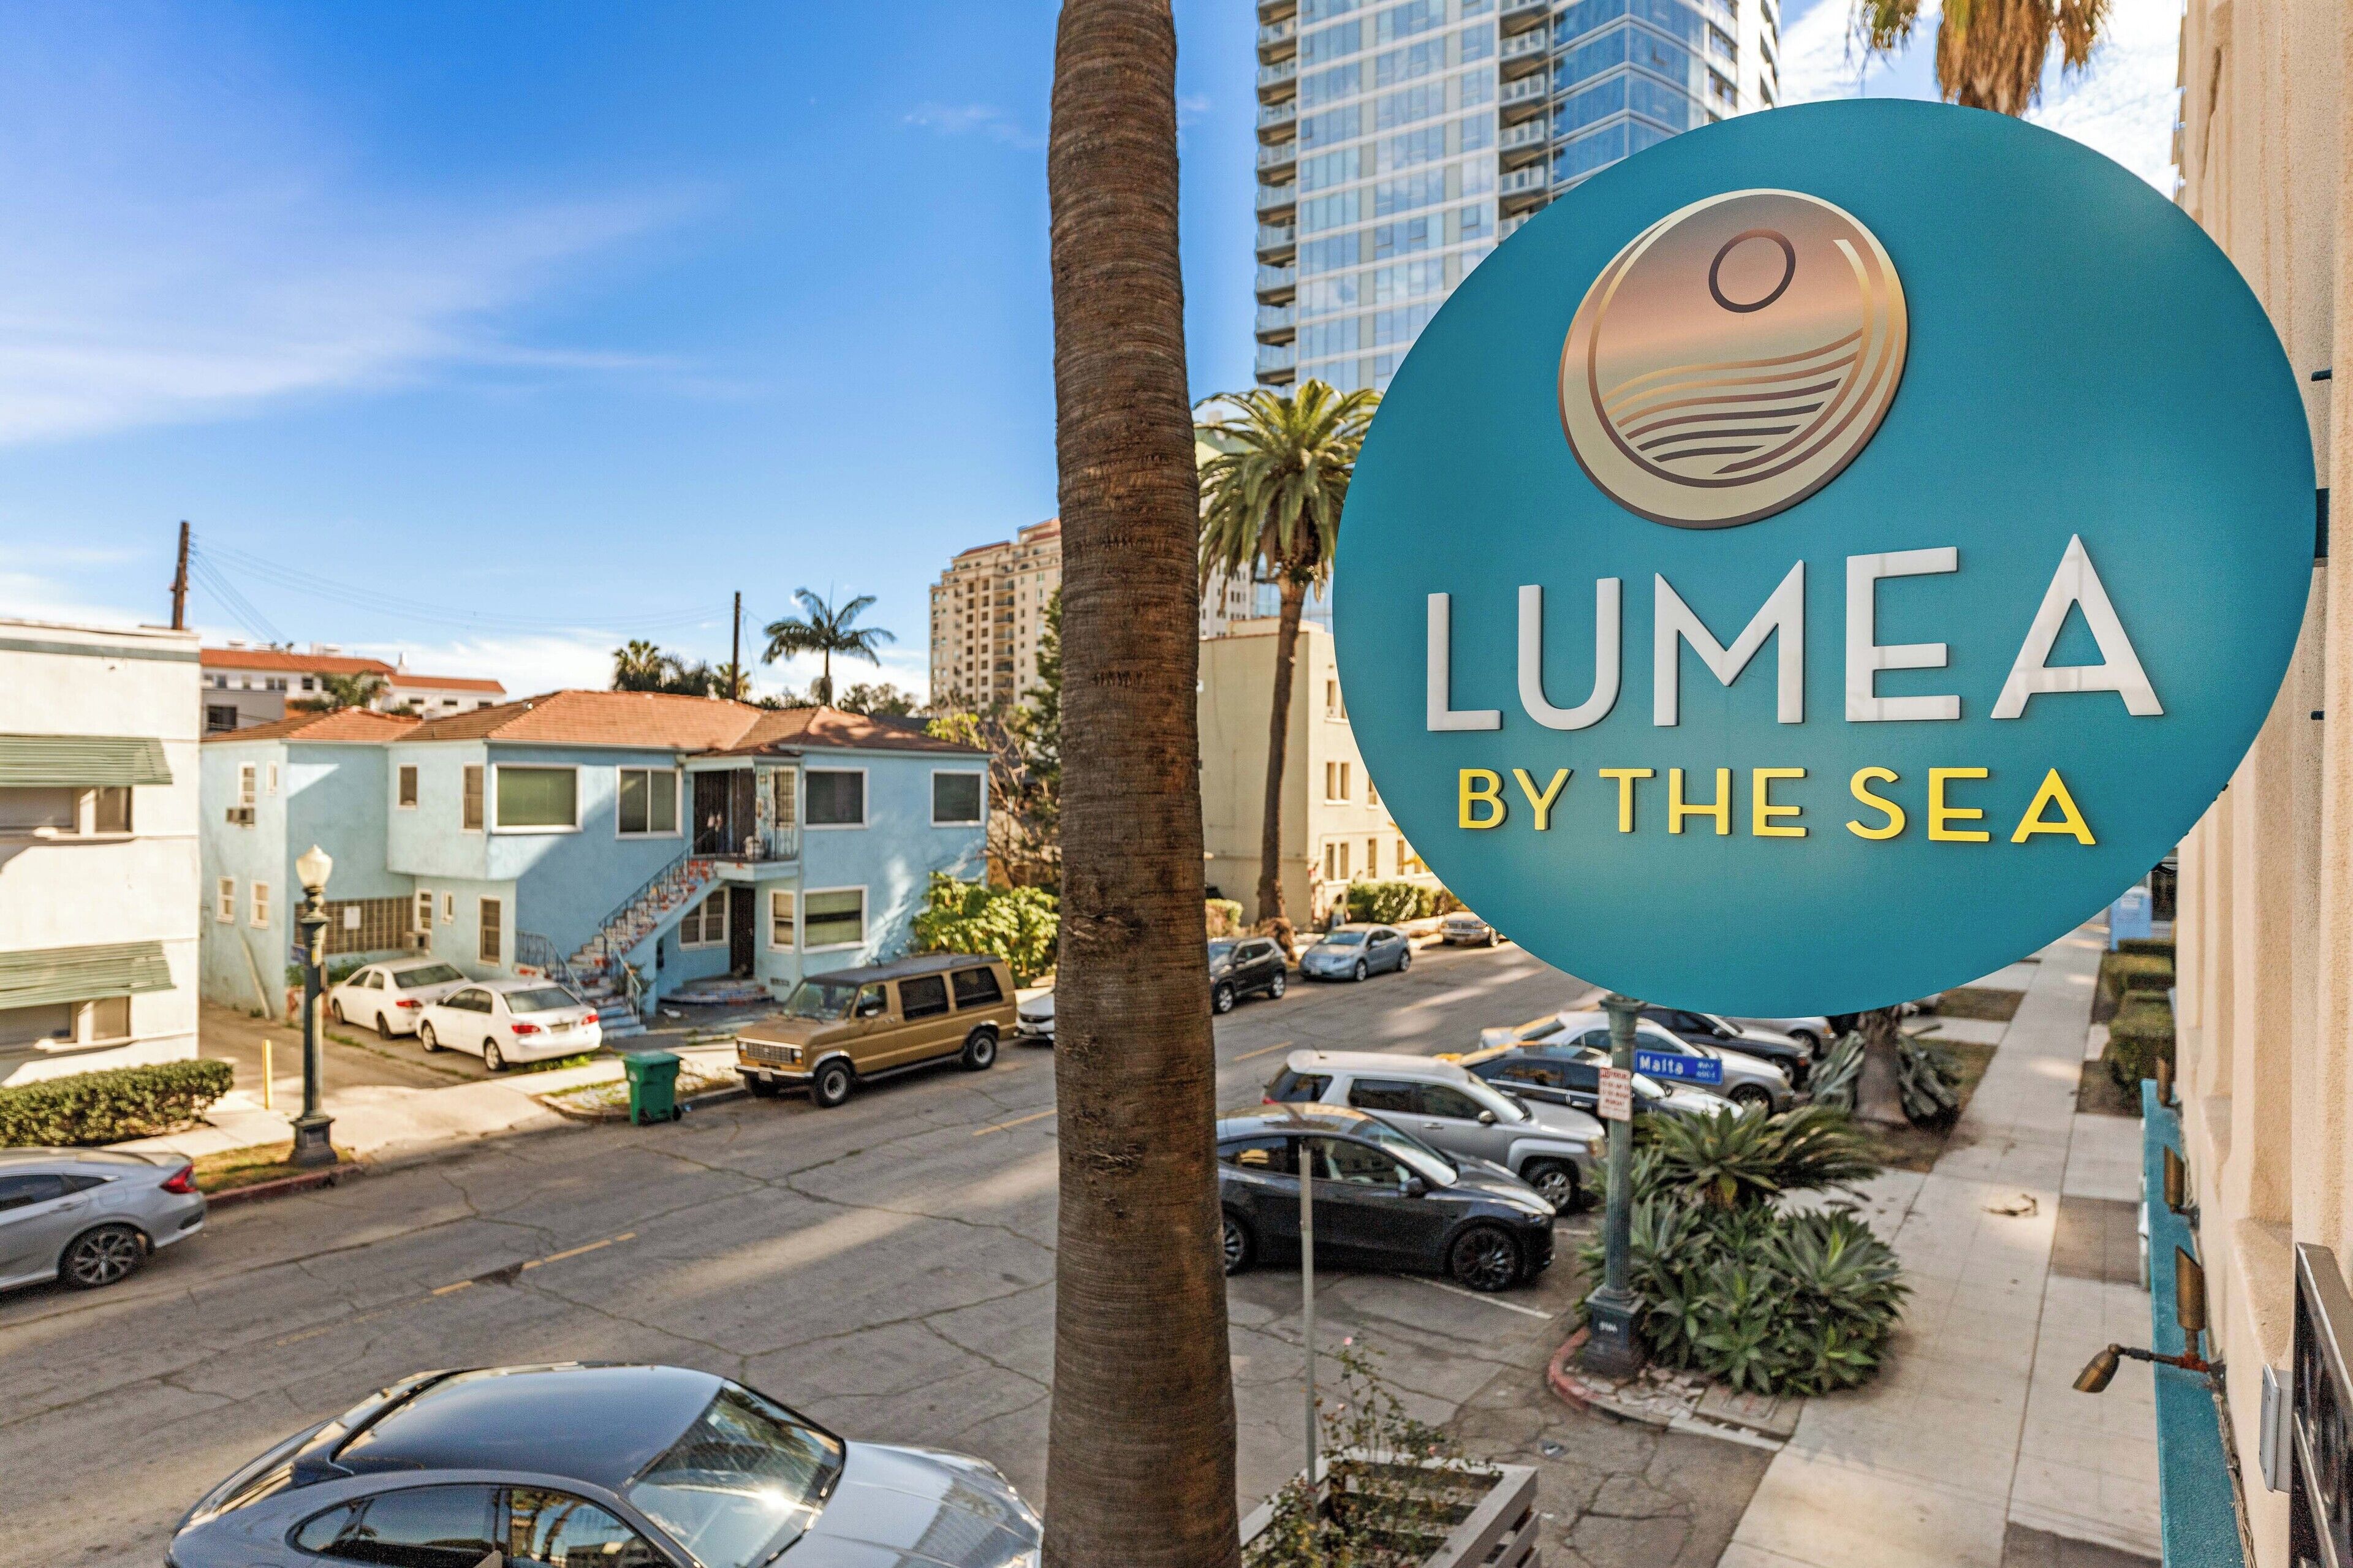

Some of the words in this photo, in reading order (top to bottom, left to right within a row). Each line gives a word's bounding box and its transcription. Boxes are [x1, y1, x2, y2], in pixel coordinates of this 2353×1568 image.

[1426, 533, 2165, 732] LUMEA
[1458, 768, 1573, 831] BY
[1599, 767, 1808, 838] THE
[1845, 766, 2096, 846] SEA
